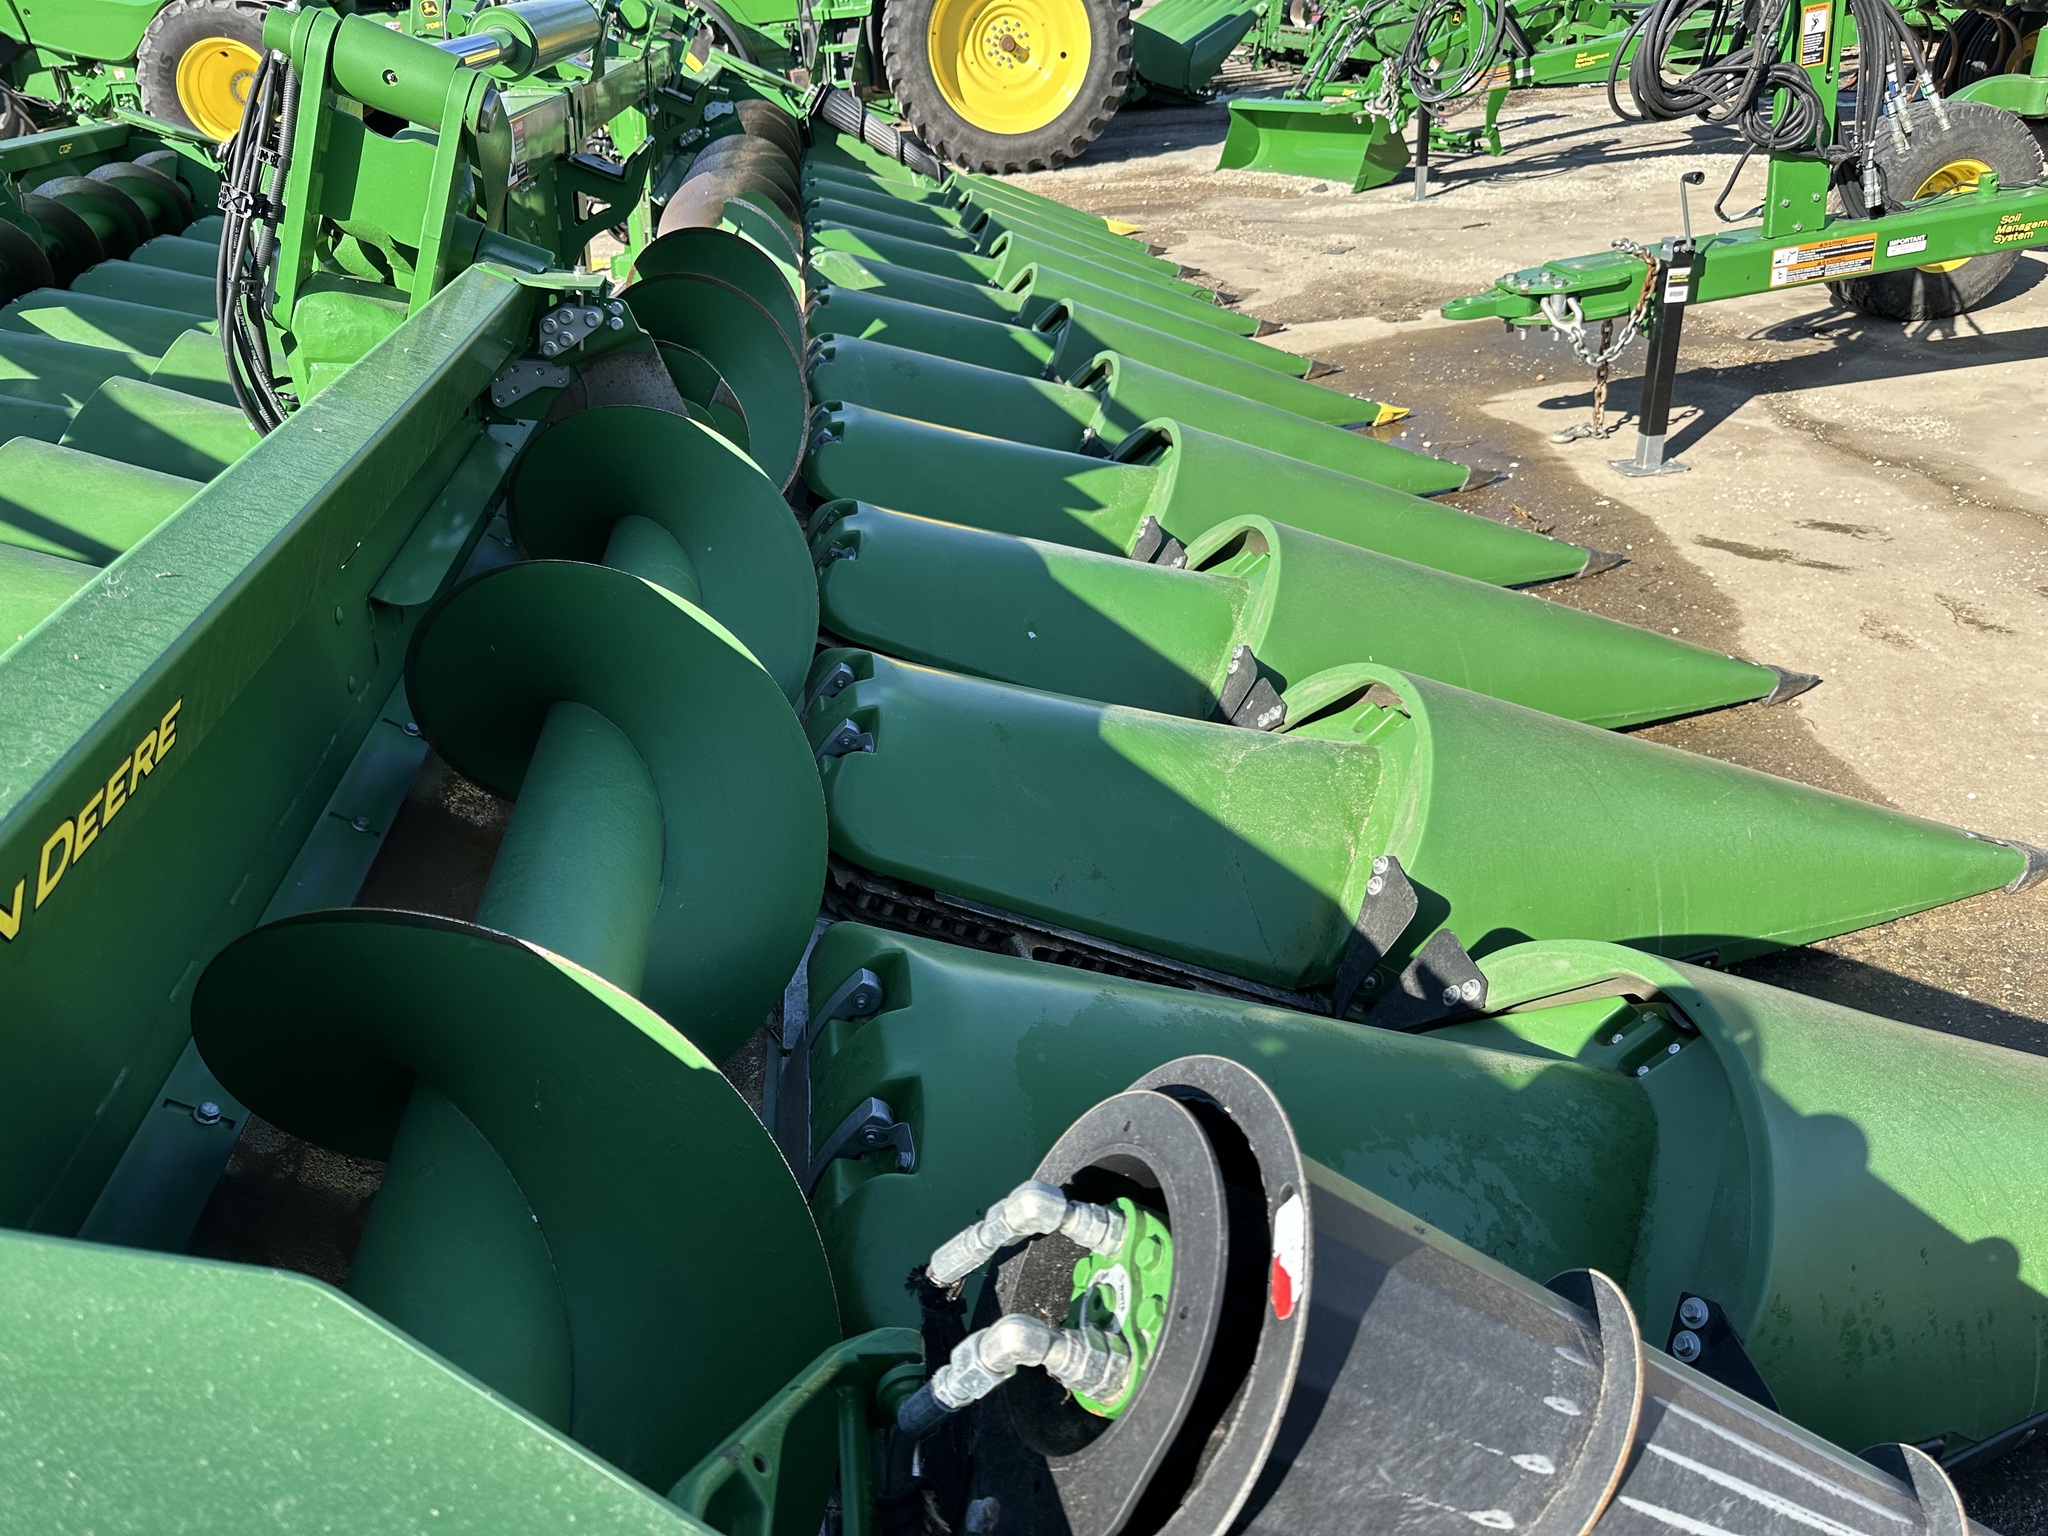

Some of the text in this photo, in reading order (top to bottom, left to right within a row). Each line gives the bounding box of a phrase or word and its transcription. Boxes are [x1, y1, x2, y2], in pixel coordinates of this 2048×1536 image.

[1999, 212, 2022, 225] Soil
[1995, 219, 2048, 235] Managem
[1824, 239, 1848, 247] WARNING
[1889, 233, 1928, 247] IMPORTANT
[1992, 231, 2035, 245] System
[1821, 257, 1846, 265] WARNING
[35, 697, 182, 911] DEERE
